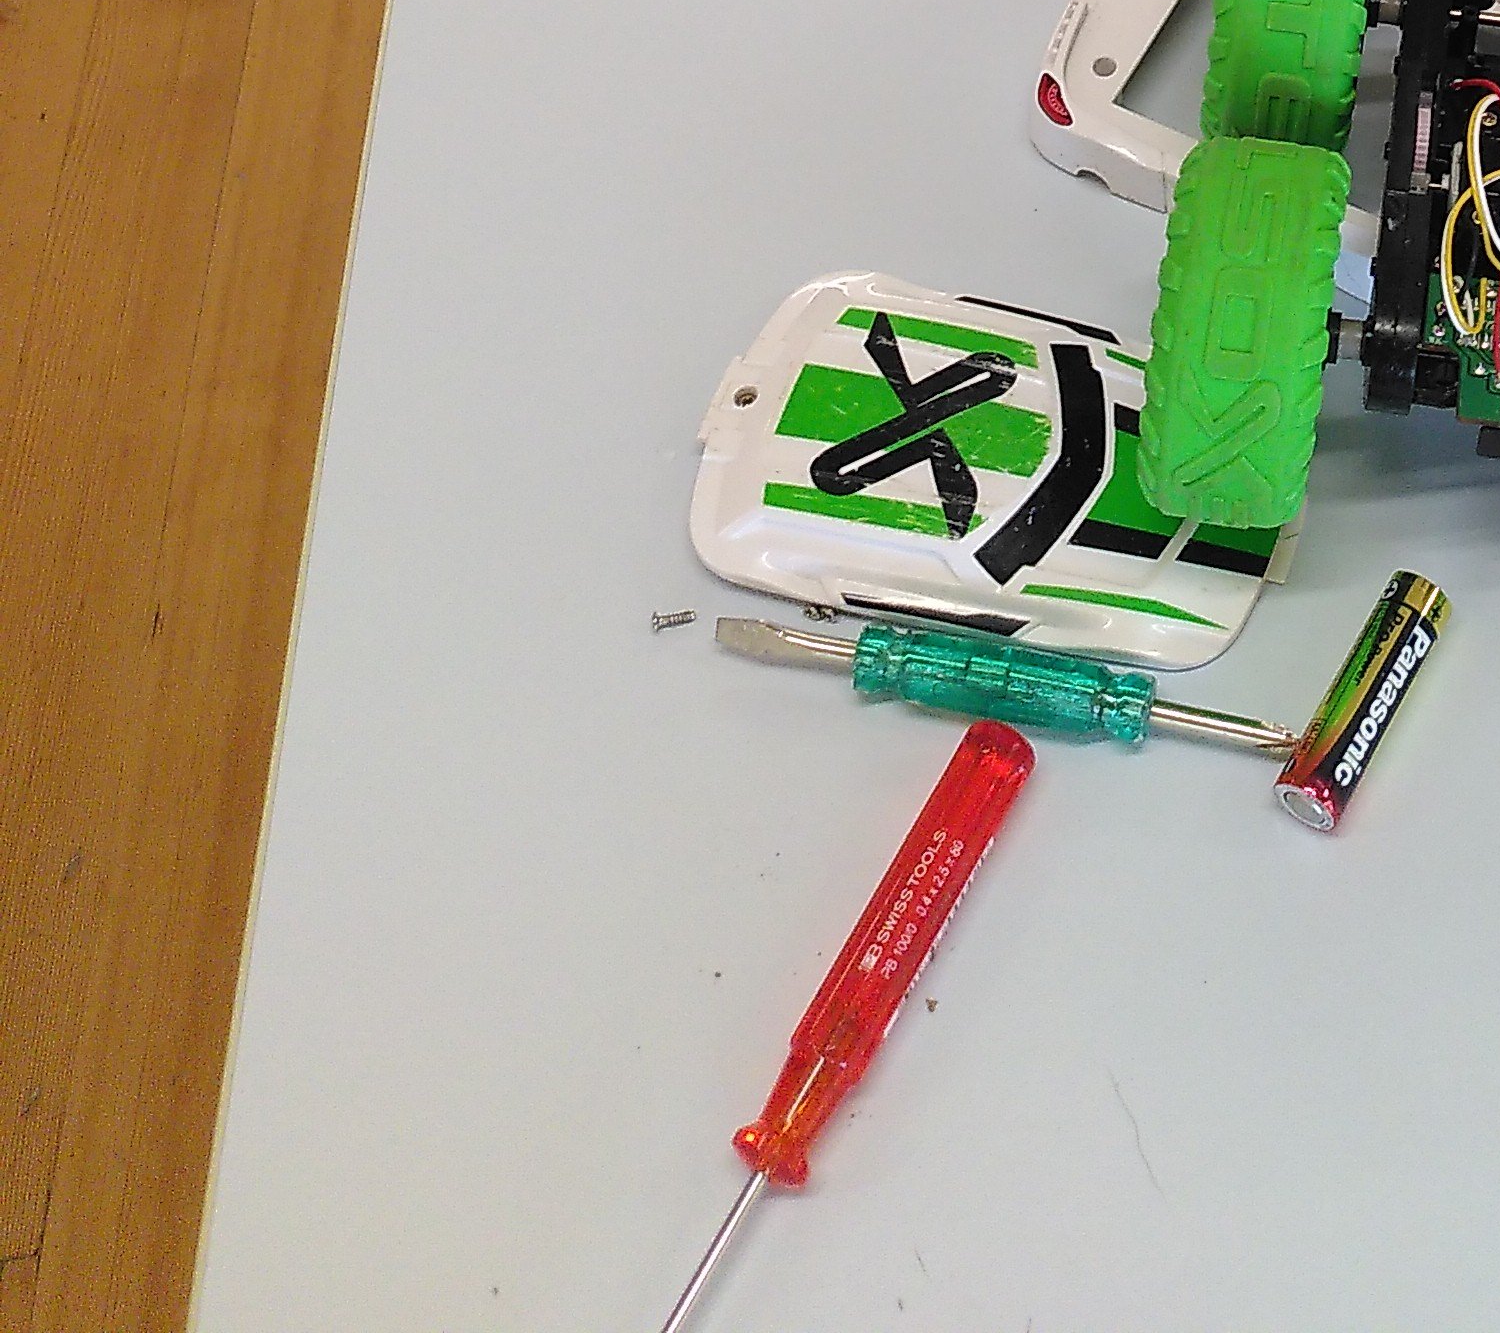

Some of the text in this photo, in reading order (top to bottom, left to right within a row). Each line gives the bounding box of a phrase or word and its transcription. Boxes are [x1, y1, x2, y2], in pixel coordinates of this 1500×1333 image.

[1334, 624, 1433, 787] Panasonic
[877, 887, 914, 944] SWISS
[907, 828, 947, 887] TOOLS
